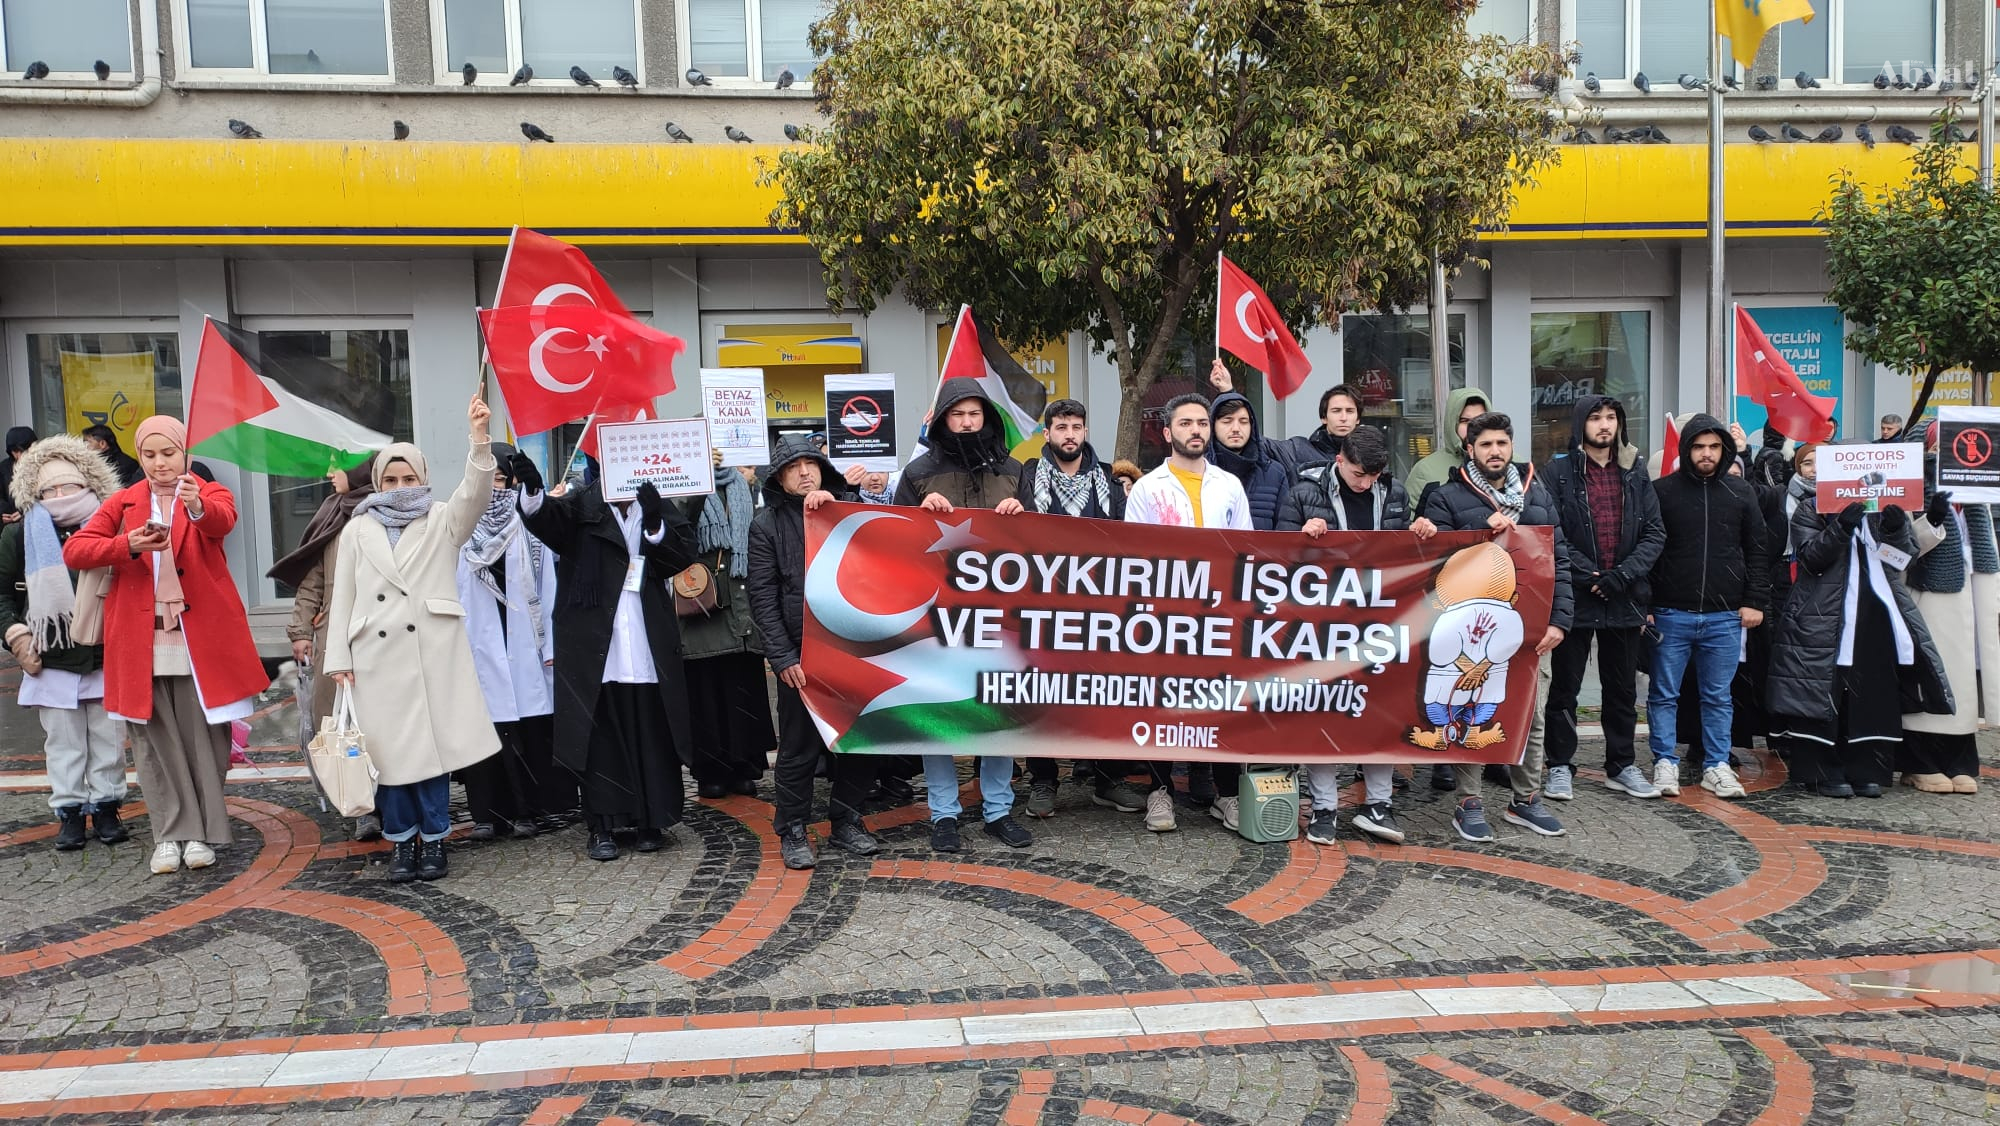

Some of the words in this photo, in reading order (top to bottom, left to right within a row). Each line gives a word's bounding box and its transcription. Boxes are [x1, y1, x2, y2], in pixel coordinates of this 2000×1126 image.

[1764, 329, 1821, 344] TCELL'İN
[714, 390, 753, 400] BEYAZ
[718, 407, 752, 417] KANA
[642, 453, 672, 466] +24
[1834, 450, 1905, 462] DOCTORS
[633, 466, 682, 476] HASTANE
[1842, 463, 1872, 471] STAND
[1874, 462, 1898, 470] WITH
[652, 475, 690, 483] ALINARAK
[616, 485, 640, 493] HİZM
[1835, 486, 1905, 498] PALESTINE
[955, 550, 1222, 608] SOYKIRIM,
[1241, 554, 1397, 615] İŞGAL
[937, 608, 1004, 649] VE
[1020, 603, 1233, 657] TERÖRE
[1250, 619, 1411, 675] KARŞI
[982, 667, 1156, 707] HEKİMLERDEN
[1162, 674, 1247, 712] SESSİZ
[1254, 677, 1369, 718] YÜRÜYÜŞ
[1155, 722, 1219, 749] EDİRNE
